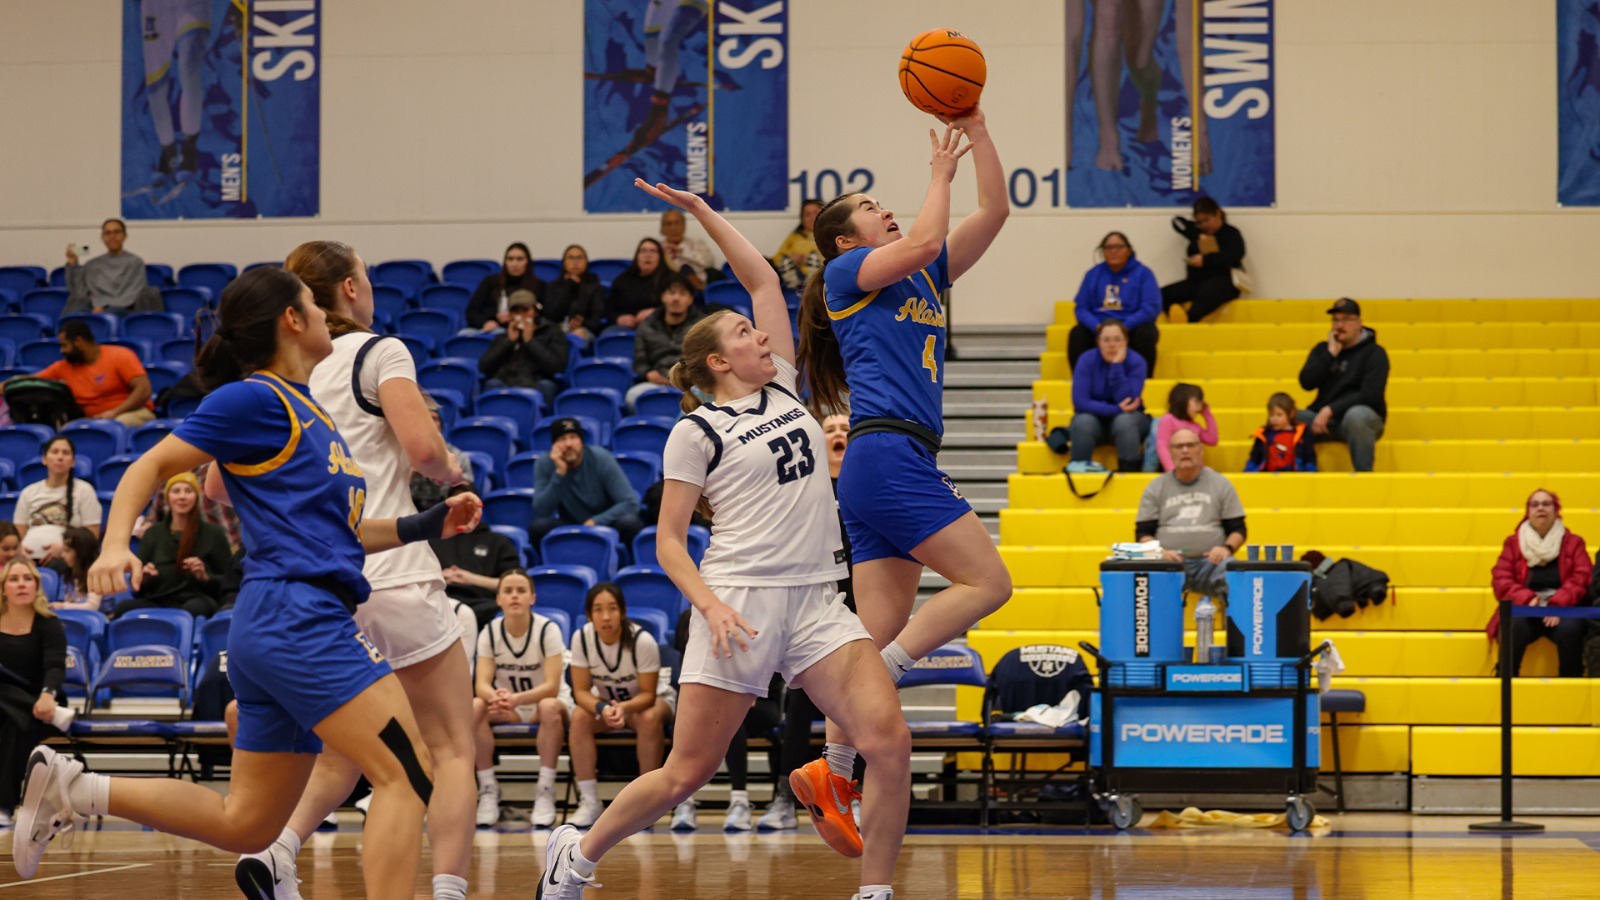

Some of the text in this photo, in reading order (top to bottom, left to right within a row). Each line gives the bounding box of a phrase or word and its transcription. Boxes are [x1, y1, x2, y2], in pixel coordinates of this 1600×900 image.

[686, 121, 707, 194] WOMEN'S
[1171, 116, 1192, 190] WOMEN'S
[221, 153, 241, 201] MEN'S
[789, 168, 874, 203] 102
[1008, 168, 1060, 208] 01
[922, 334, 938, 383] 4
[737, 407, 806, 445] MUSTANGS
[767, 427, 815, 485] 23
[1135, 576, 1148, 654] POWERADE
[1252, 577, 1264, 655] POWERADE
[508, 676, 534, 693] 10
[605, 686, 632, 701] 12
[1171, 673, 1242, 683] POWERADE
[1121, 724, 1285, 743] POWERADE
